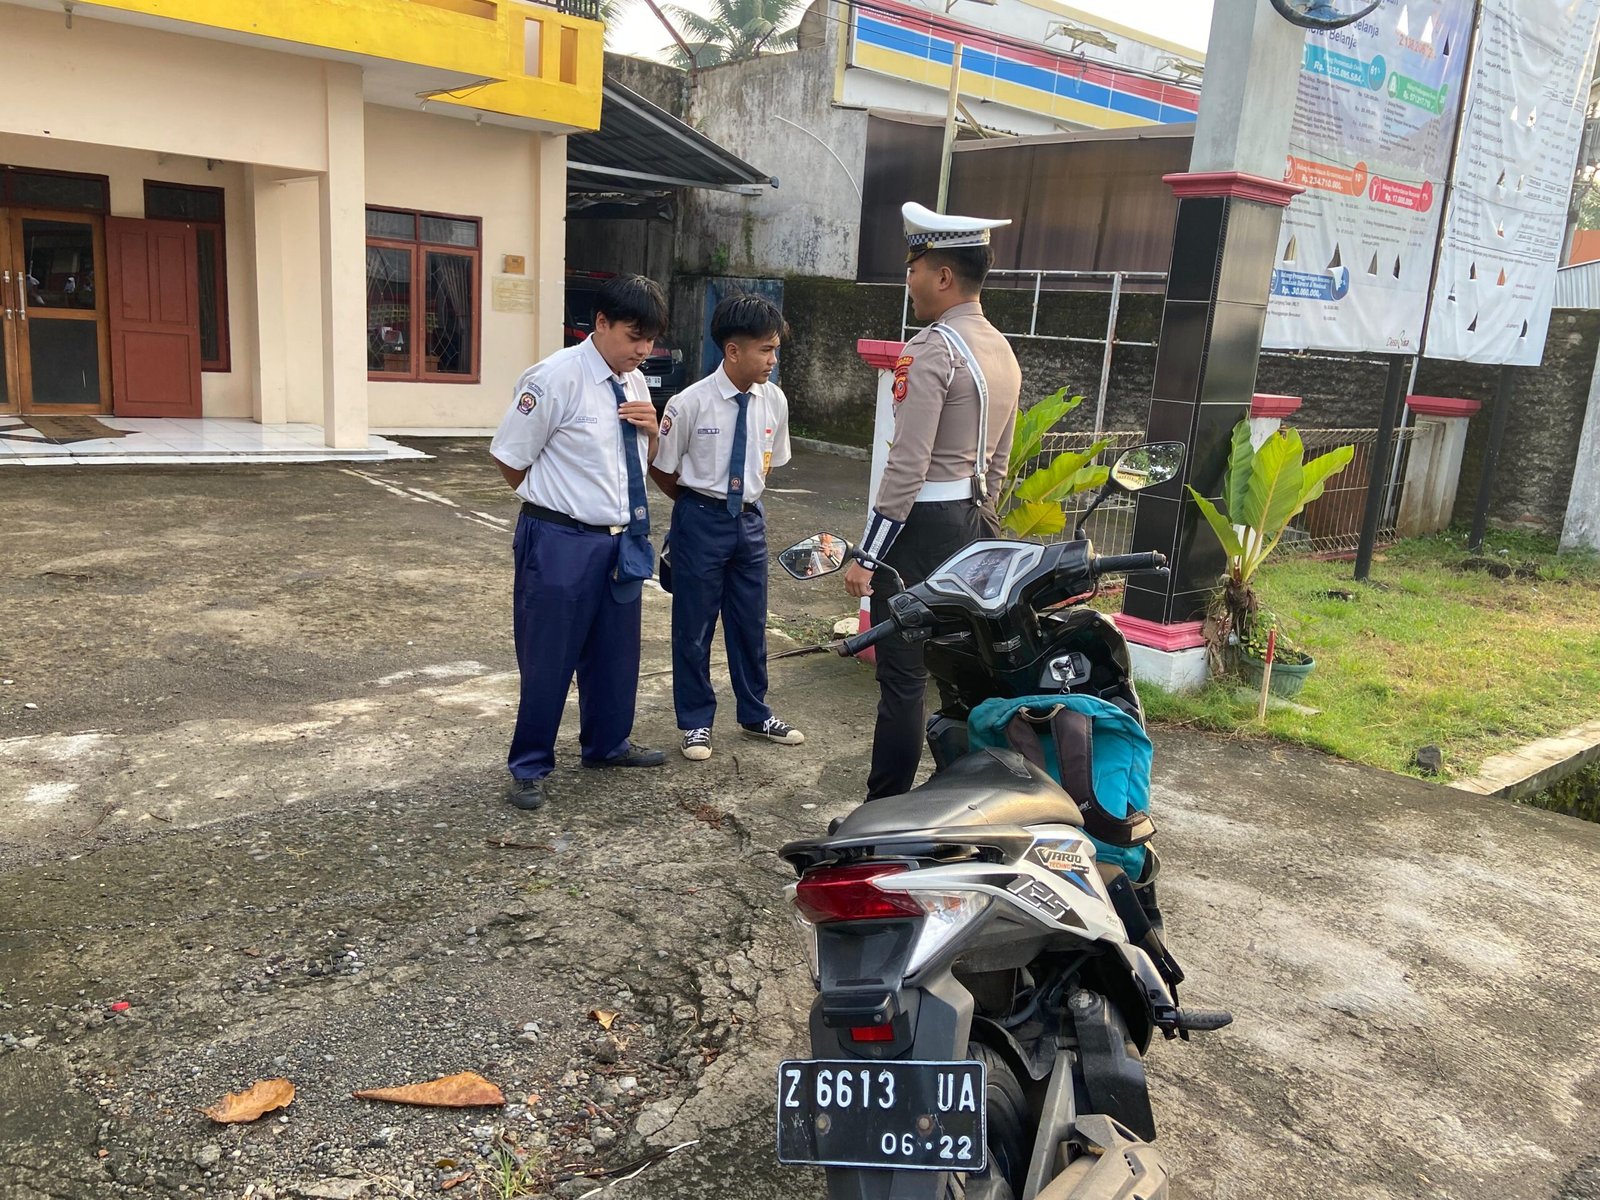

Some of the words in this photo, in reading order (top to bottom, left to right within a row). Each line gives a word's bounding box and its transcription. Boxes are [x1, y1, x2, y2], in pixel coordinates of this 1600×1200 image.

[1329, 30, 1358, 49] Belanja
[1034, 847, 1081, 865] VARIO
[1006, 873, 1070, 920] 125
[785, 1069, 801, 1108] Z
[816, 1069, 895, 1109] 6613
[937, 1072, 976, 1112] UA
